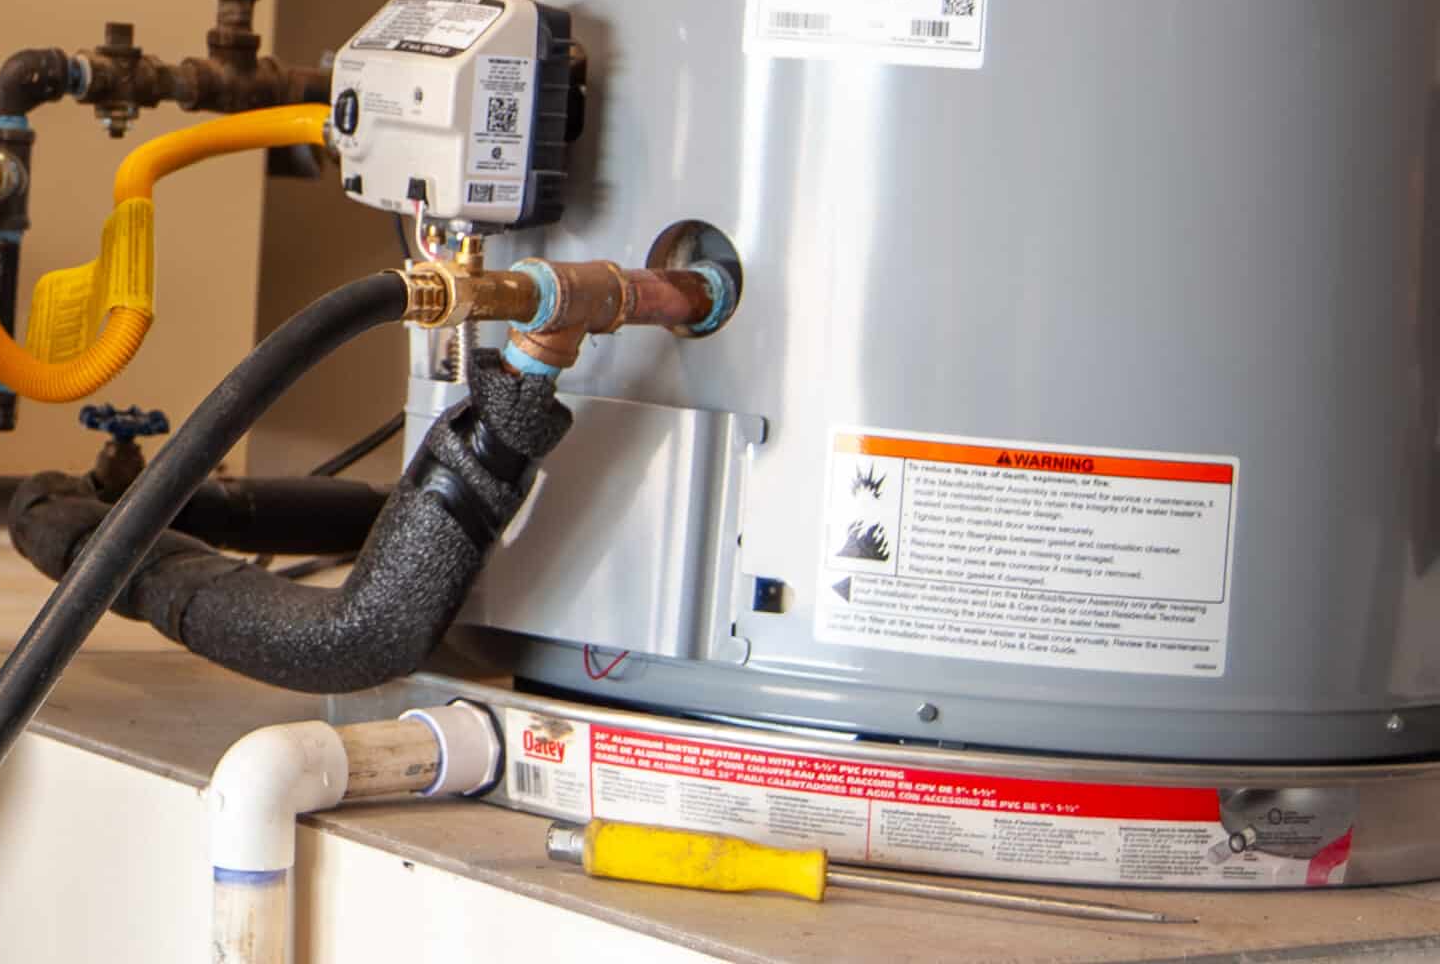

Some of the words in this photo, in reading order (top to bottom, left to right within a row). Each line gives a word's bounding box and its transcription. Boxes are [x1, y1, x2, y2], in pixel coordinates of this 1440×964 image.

[1015, 452, 1095, 473] WARNING
[523, 730, 565, 763] Oatey
[665, 742, 701, 755] WATER
[701, 747, 742, 760] HEATER
[743, 753, 766, 763] PAN
[767, 756, 796, 767] WITH
[839, 765, 861, 775] PVC
[862, 768, 905, 780] FITTING
[736, 772, 765, 783] PARA
[767, 777, 848, 794] CALENTADORES
[849, 786, 864, 796] DE
[866, 787, 896, 798] AGUA
[898, 791, 921, 801] CON
[922, 794, 980, 807] ACCESORIO
[982, 798, 998, 808] DE
[999, 800, 1021, 810] PVC
[817, 773, 845, 783] AVEC
[847, 776, 896, 789] RACCORD
[898, 782, 913, 790] EN
[915, 783, 937, 792] CPV
[938, 785, 953, 794] DE
